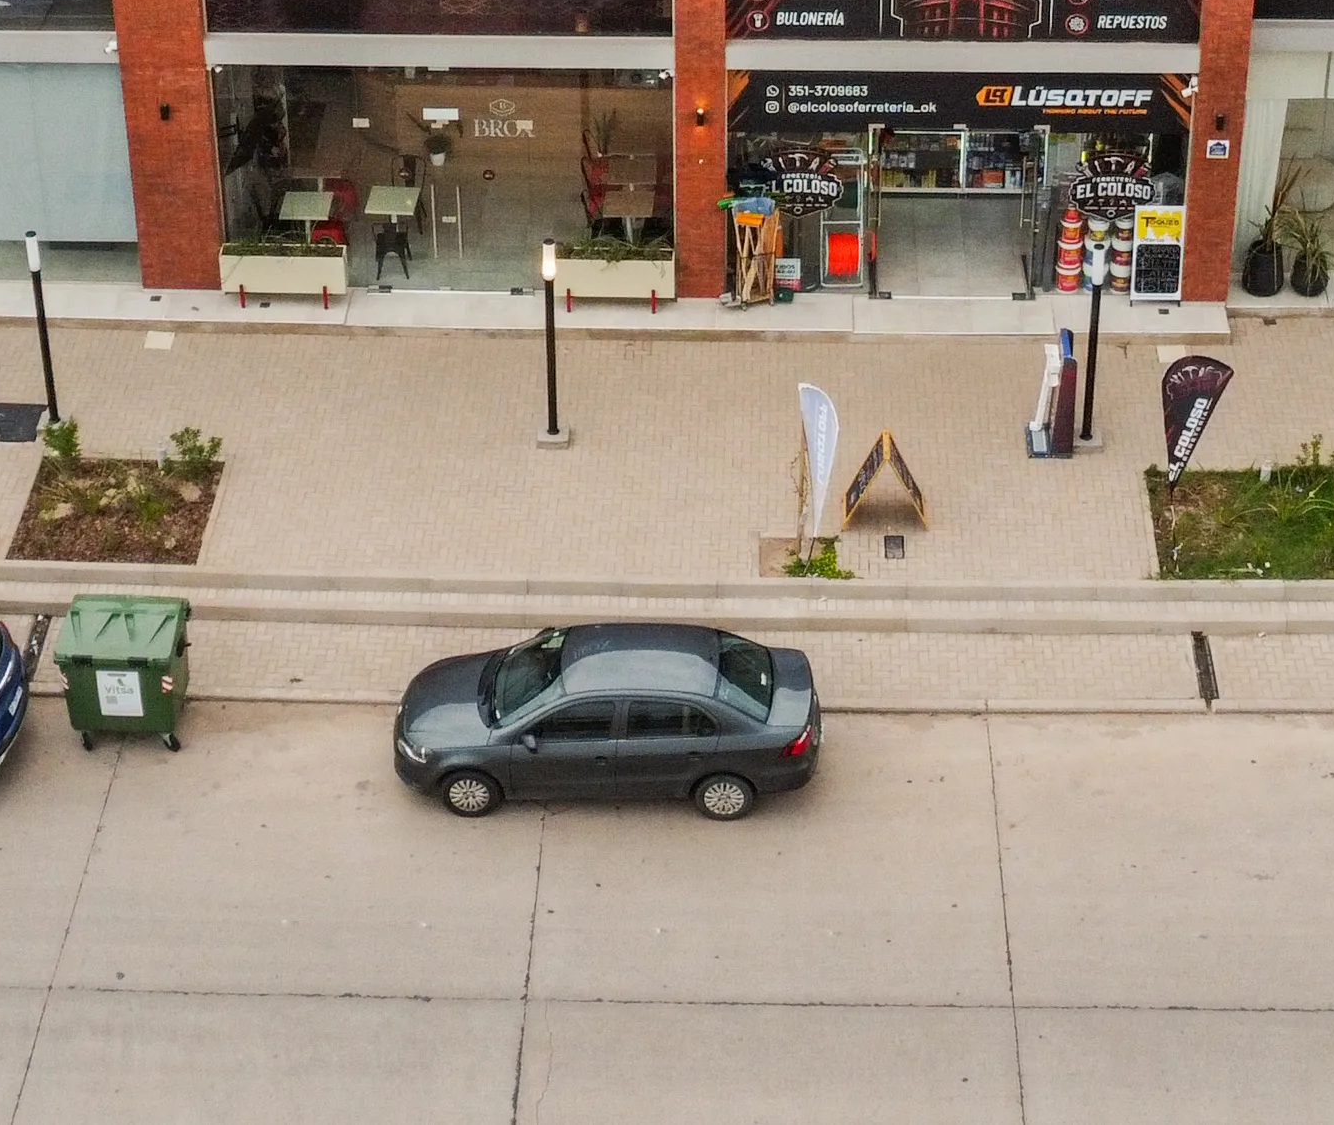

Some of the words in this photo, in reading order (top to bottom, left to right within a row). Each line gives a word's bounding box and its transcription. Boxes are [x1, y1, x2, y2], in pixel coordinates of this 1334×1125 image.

[775, 9, 846, 26] BULONERÍA
[1097, 15, 1168, 30] REPUESTOS
[788, 85, 869, 98] 351-3709683
[783, 179, 838, 197] COLOSO
[1076, 184, 1094, 198] EL
[1098, 183, 1151, 199] COLOSO
[1173, 396, 1208, 459] COLOSO
